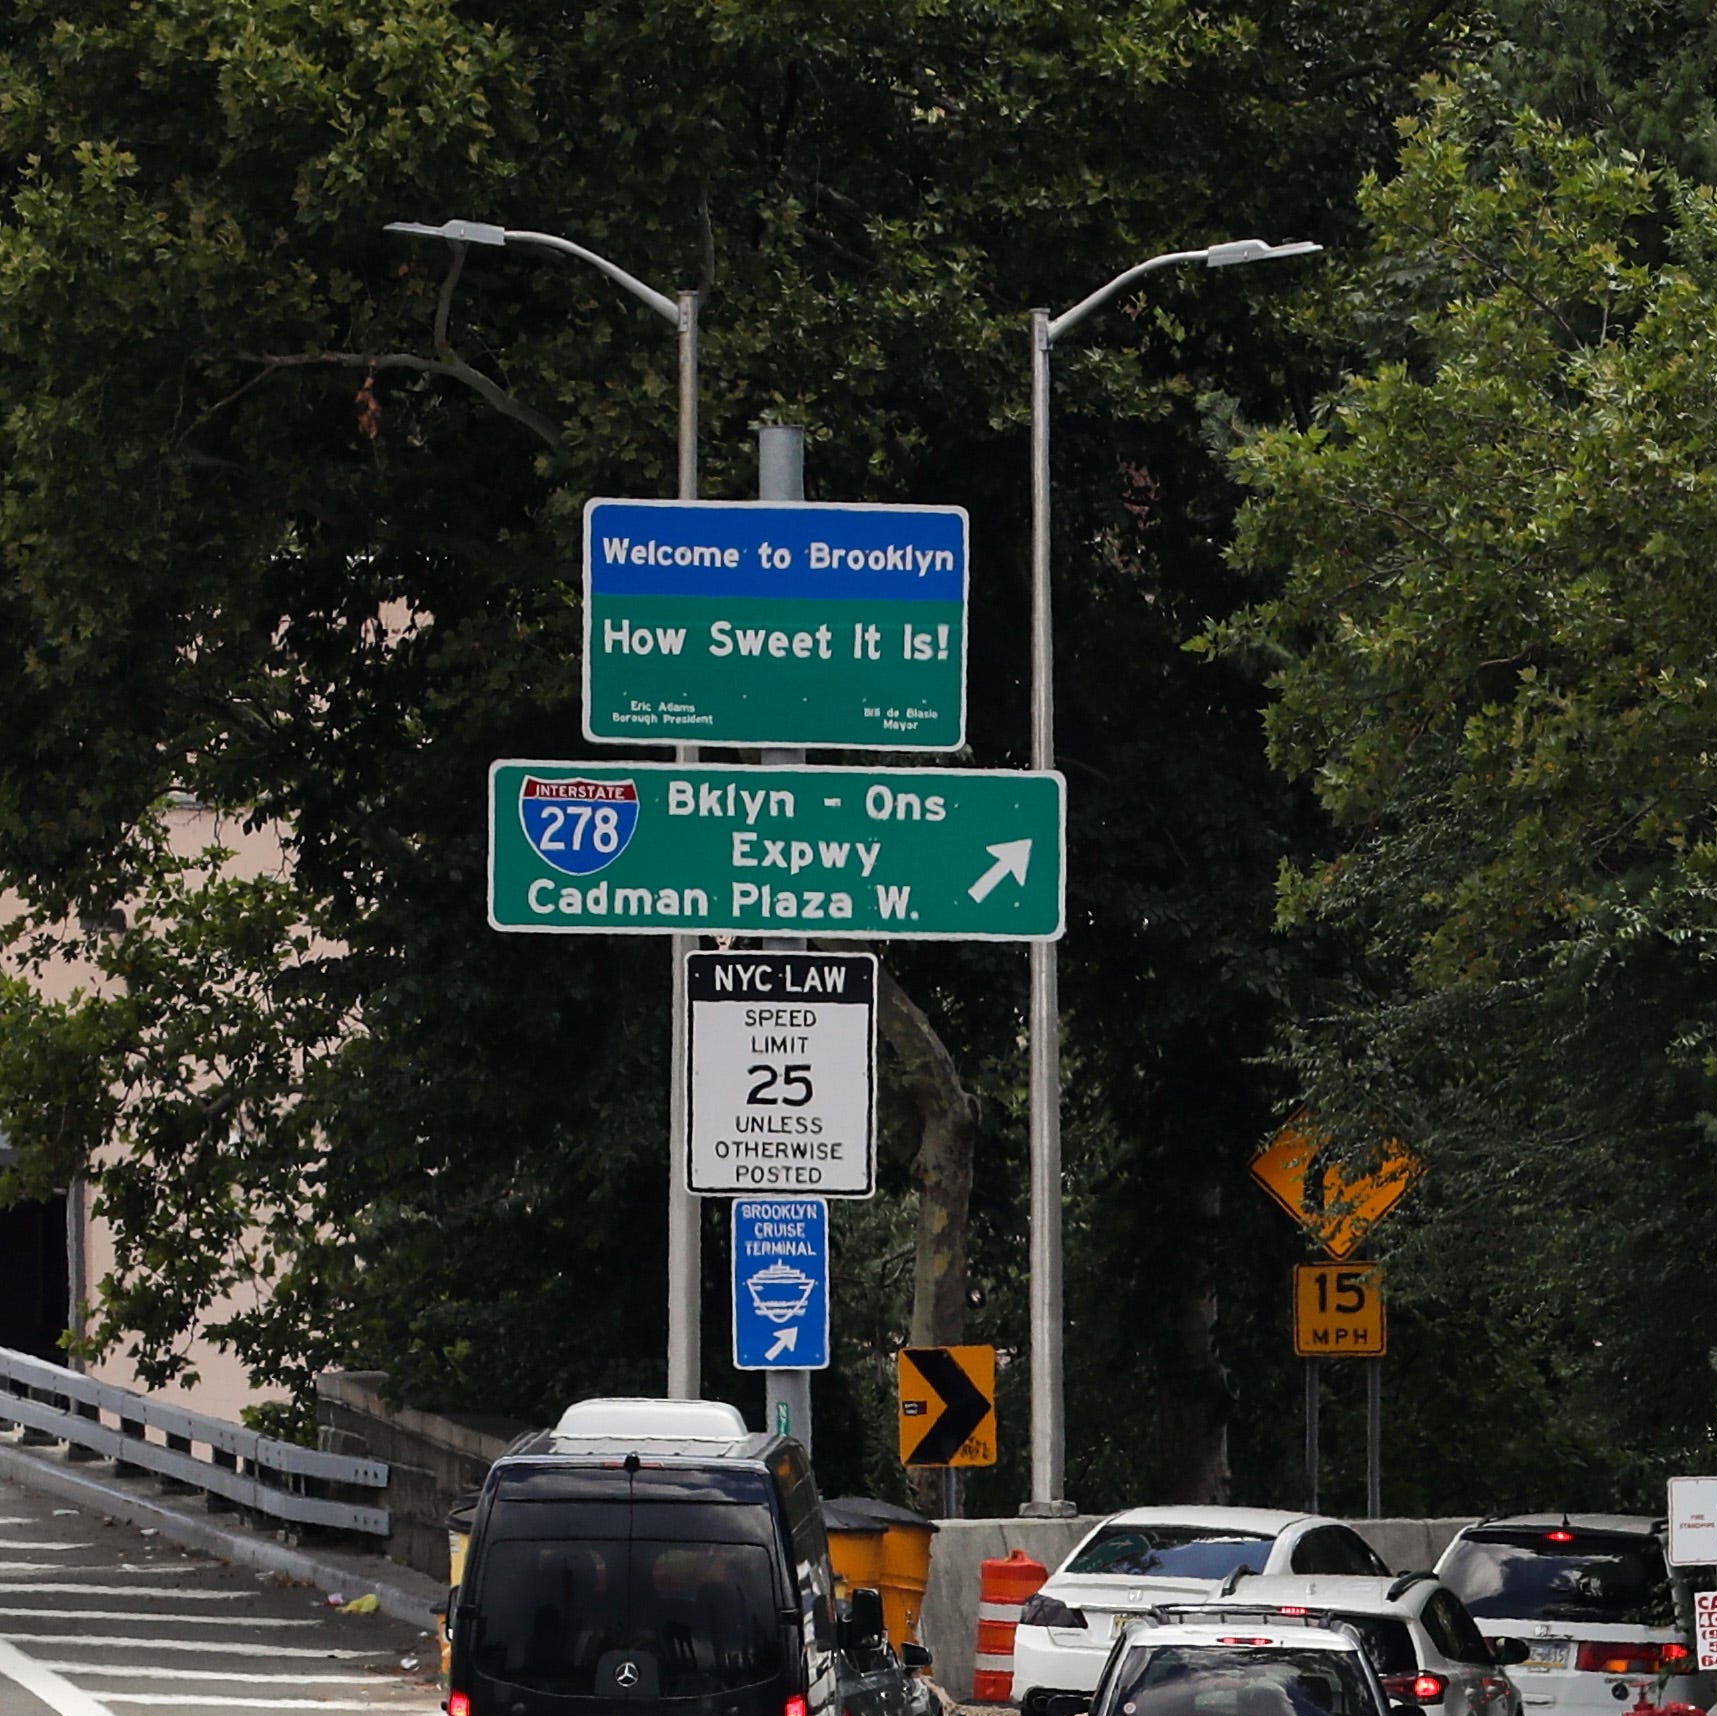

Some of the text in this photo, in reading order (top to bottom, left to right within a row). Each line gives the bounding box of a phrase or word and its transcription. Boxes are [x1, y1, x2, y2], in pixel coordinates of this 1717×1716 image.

[602, 537, 954, 577] Welcome to Brooklyn
[603, 619, 950, 660] How Sweet It Is!
[630, 700, 695, 713] Eric Adams
[887, 708, 899, 719] de
[612, 712, 714, 726] Borough President
[883, 719, 919, 732] Mayor
[534, 783, 625, 800] INTERSTATE
[668, 781, 795, 825] Bklyn
[865, 784, 946, 822] Ons
[539, 806, 619, 853] 278
[731, 832, 881, 876] Expwy
[527, 878, 919, 921] Cadman Plaza W.
[715, 964, 846, 993] NYC LAW
[745, 1009, 817, 1027] SPEED
[751, 1036, 809, 1054] LIMIT
[746, 1064, 813, 1107] 25
[735, 1115, 823, 1134] UNLESS
[715, 1141, 843, 1160] OTHERWISE
[735, 1165, 822, 1184] POSTED
[742, 1203, 817, 1220] BROOKLYN
[754, 1222, 806, 1239] CRUISE
[745, 1240, 816, 1256] TERMINAL
[1315, 1272, 1365, 1313] 15
[1313, 1328, 1367, 1344] MPH
